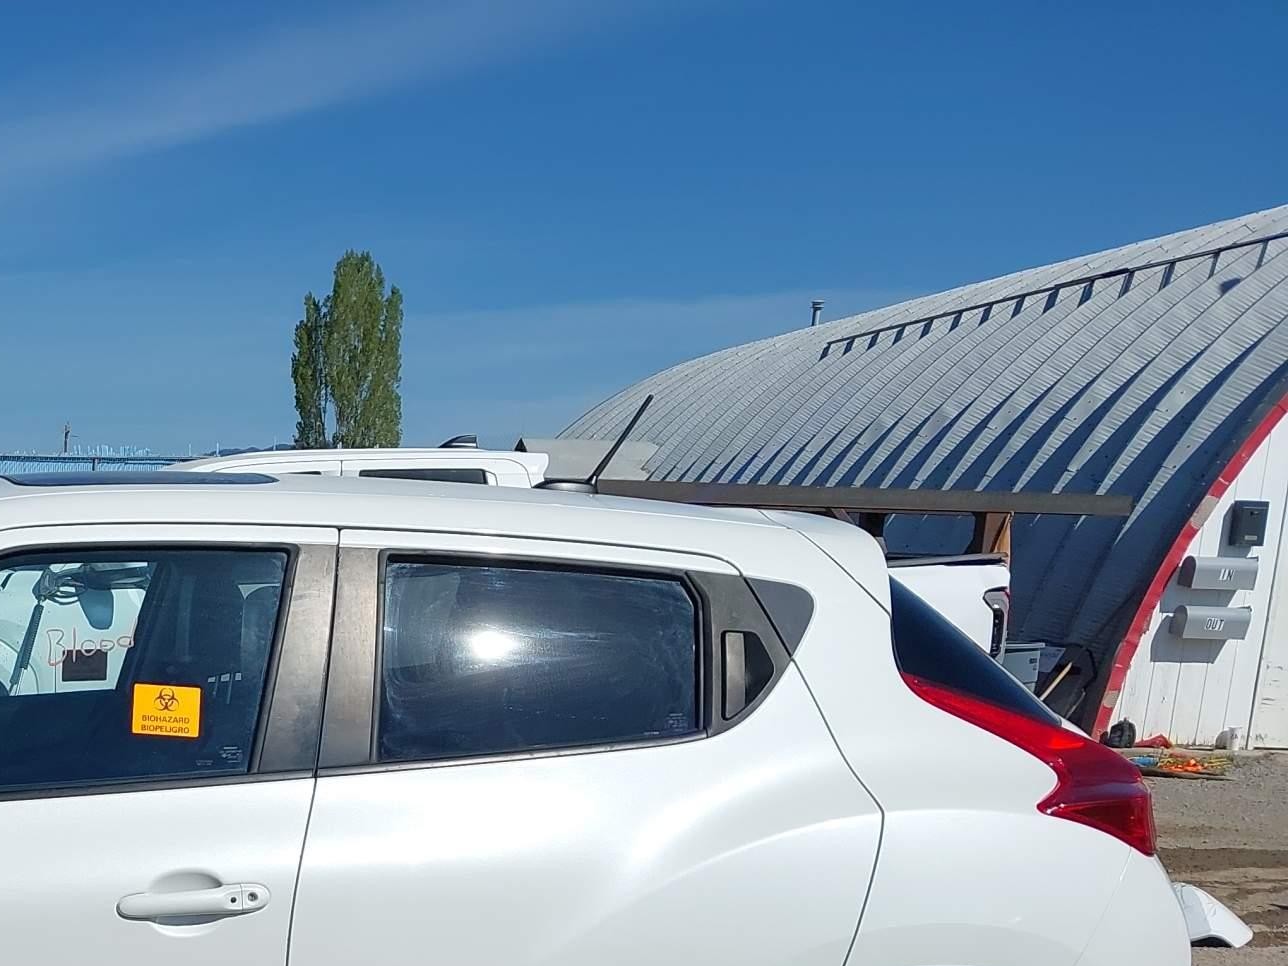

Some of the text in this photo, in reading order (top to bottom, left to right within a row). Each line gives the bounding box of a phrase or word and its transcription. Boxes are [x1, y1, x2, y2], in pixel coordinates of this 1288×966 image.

[1220, 568, 1235, 581] IN
[1205, 618, 1224, 631] OUT
[46, 617, 136, 667] Blood
[141, 714, 190, 725] BIOHAZARD
[140, 724, 190, 734] BIOPELIGRO
